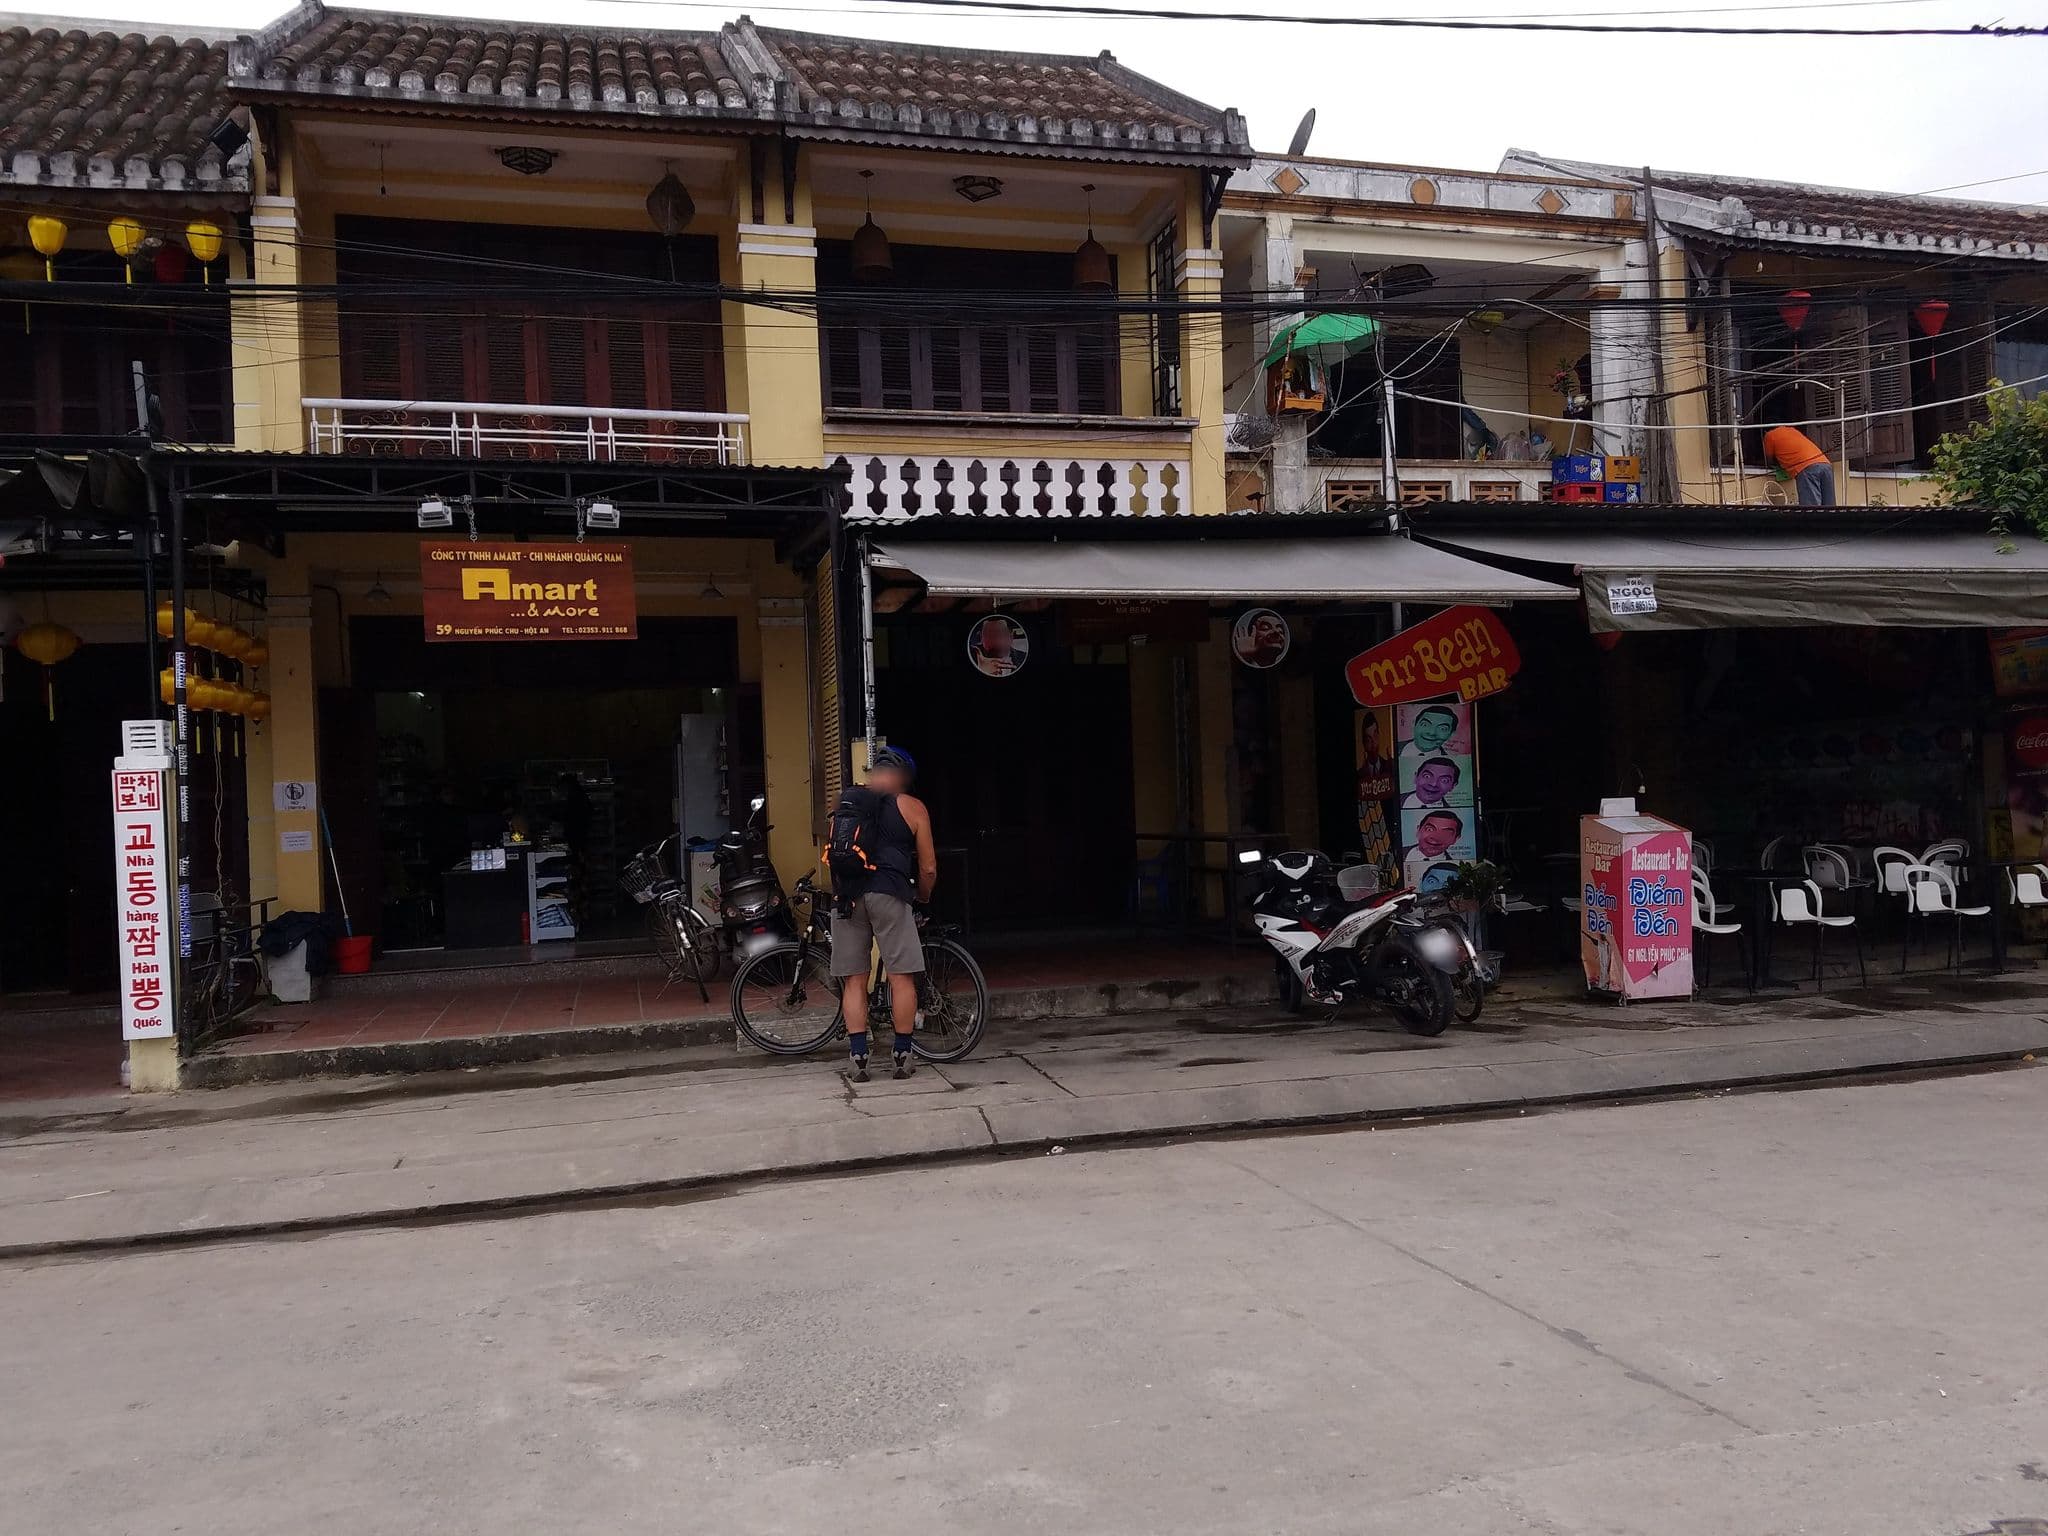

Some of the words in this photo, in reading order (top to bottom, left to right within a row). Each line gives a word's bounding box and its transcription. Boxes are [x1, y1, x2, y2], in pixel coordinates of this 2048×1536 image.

[431, 549, 454, 561] CÔNG
[455, 551, 466, 561] TY
[468, 551, 490, 561] TNHH
[493, 552, 521, 561] AMART
[529, 551, 543, 561] CHI
[544, 550, 573, 561] NHÁNH
[574, 550, 603, 563] QUẢNG
[604, 552, 623, 562] NAM
[461, 568, 597, 601] Amart
[1610, 587, 1652, 598] NGỌC
[436, 625, 452, 635] 59
[539, 627, 549, 635] AN
[1459, 666, 1508, 700] BAR
[1585, 837, 1622, 856] Restaurant
[126, 854, 154, 867] Nhà
[1595, 855, 1612, 872] Bar
[1631, 846, 1671, 871] Restaurant
[1675, 847, 1689, 870] Bar
[1628, 875, 1684, 907] Điểm
[126, 911, 159, 923] hàng
[1633, 908, 1679, 937] Đến
[1660, 944, 1676, 962] PHÚC
[132, 962, 159, 974] Hàn
[133, 1016, 162, 1029] Quốc
